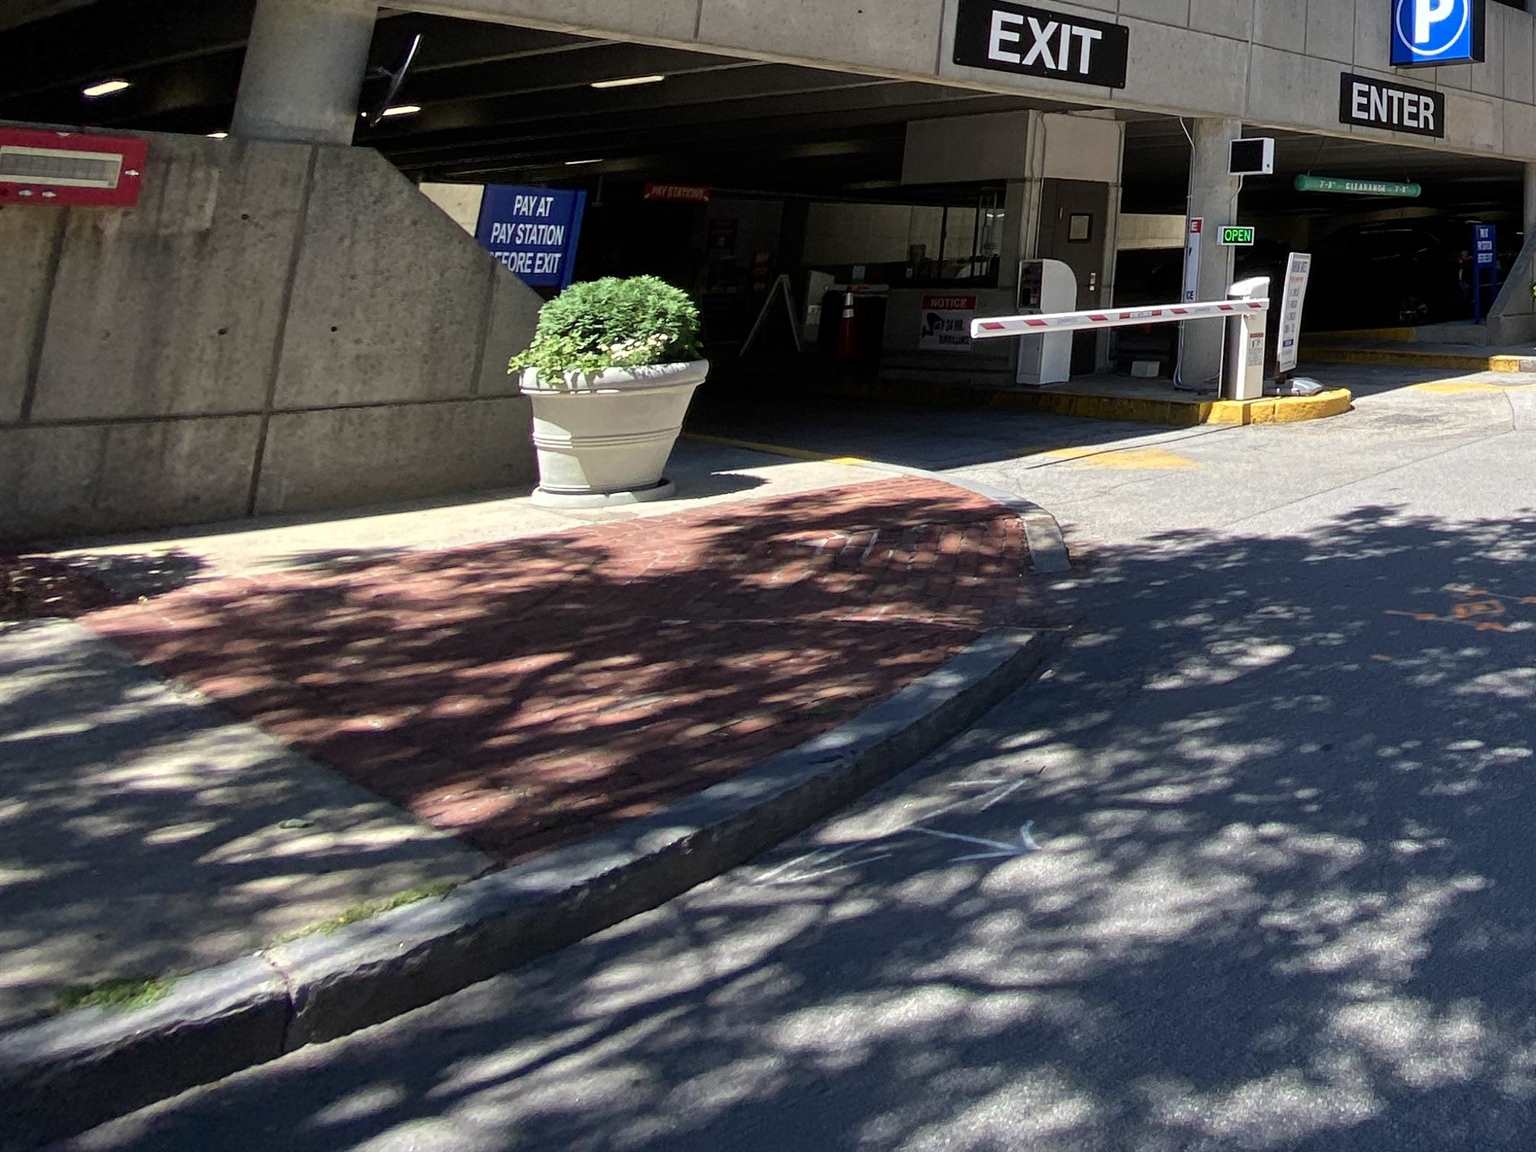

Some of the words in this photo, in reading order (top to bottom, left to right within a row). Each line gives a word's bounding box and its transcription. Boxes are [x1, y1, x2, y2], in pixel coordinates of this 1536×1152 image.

[988, 9, 1103, 75] EXIT
[1351, 81, 1435, 130] ENTER
[512, 194, 537, 217] PAY
[536, 196, 554, 217] AT
[490, 222, 515, 244] PAY
[515, 223, 564, 246] STATION
[1224, 229, 1251, 242] OPEN
[489, 251, 534, 273] FORE
[533, 252, 561, 274] EXIT
[929, 297, 968, 308] NOTICE
